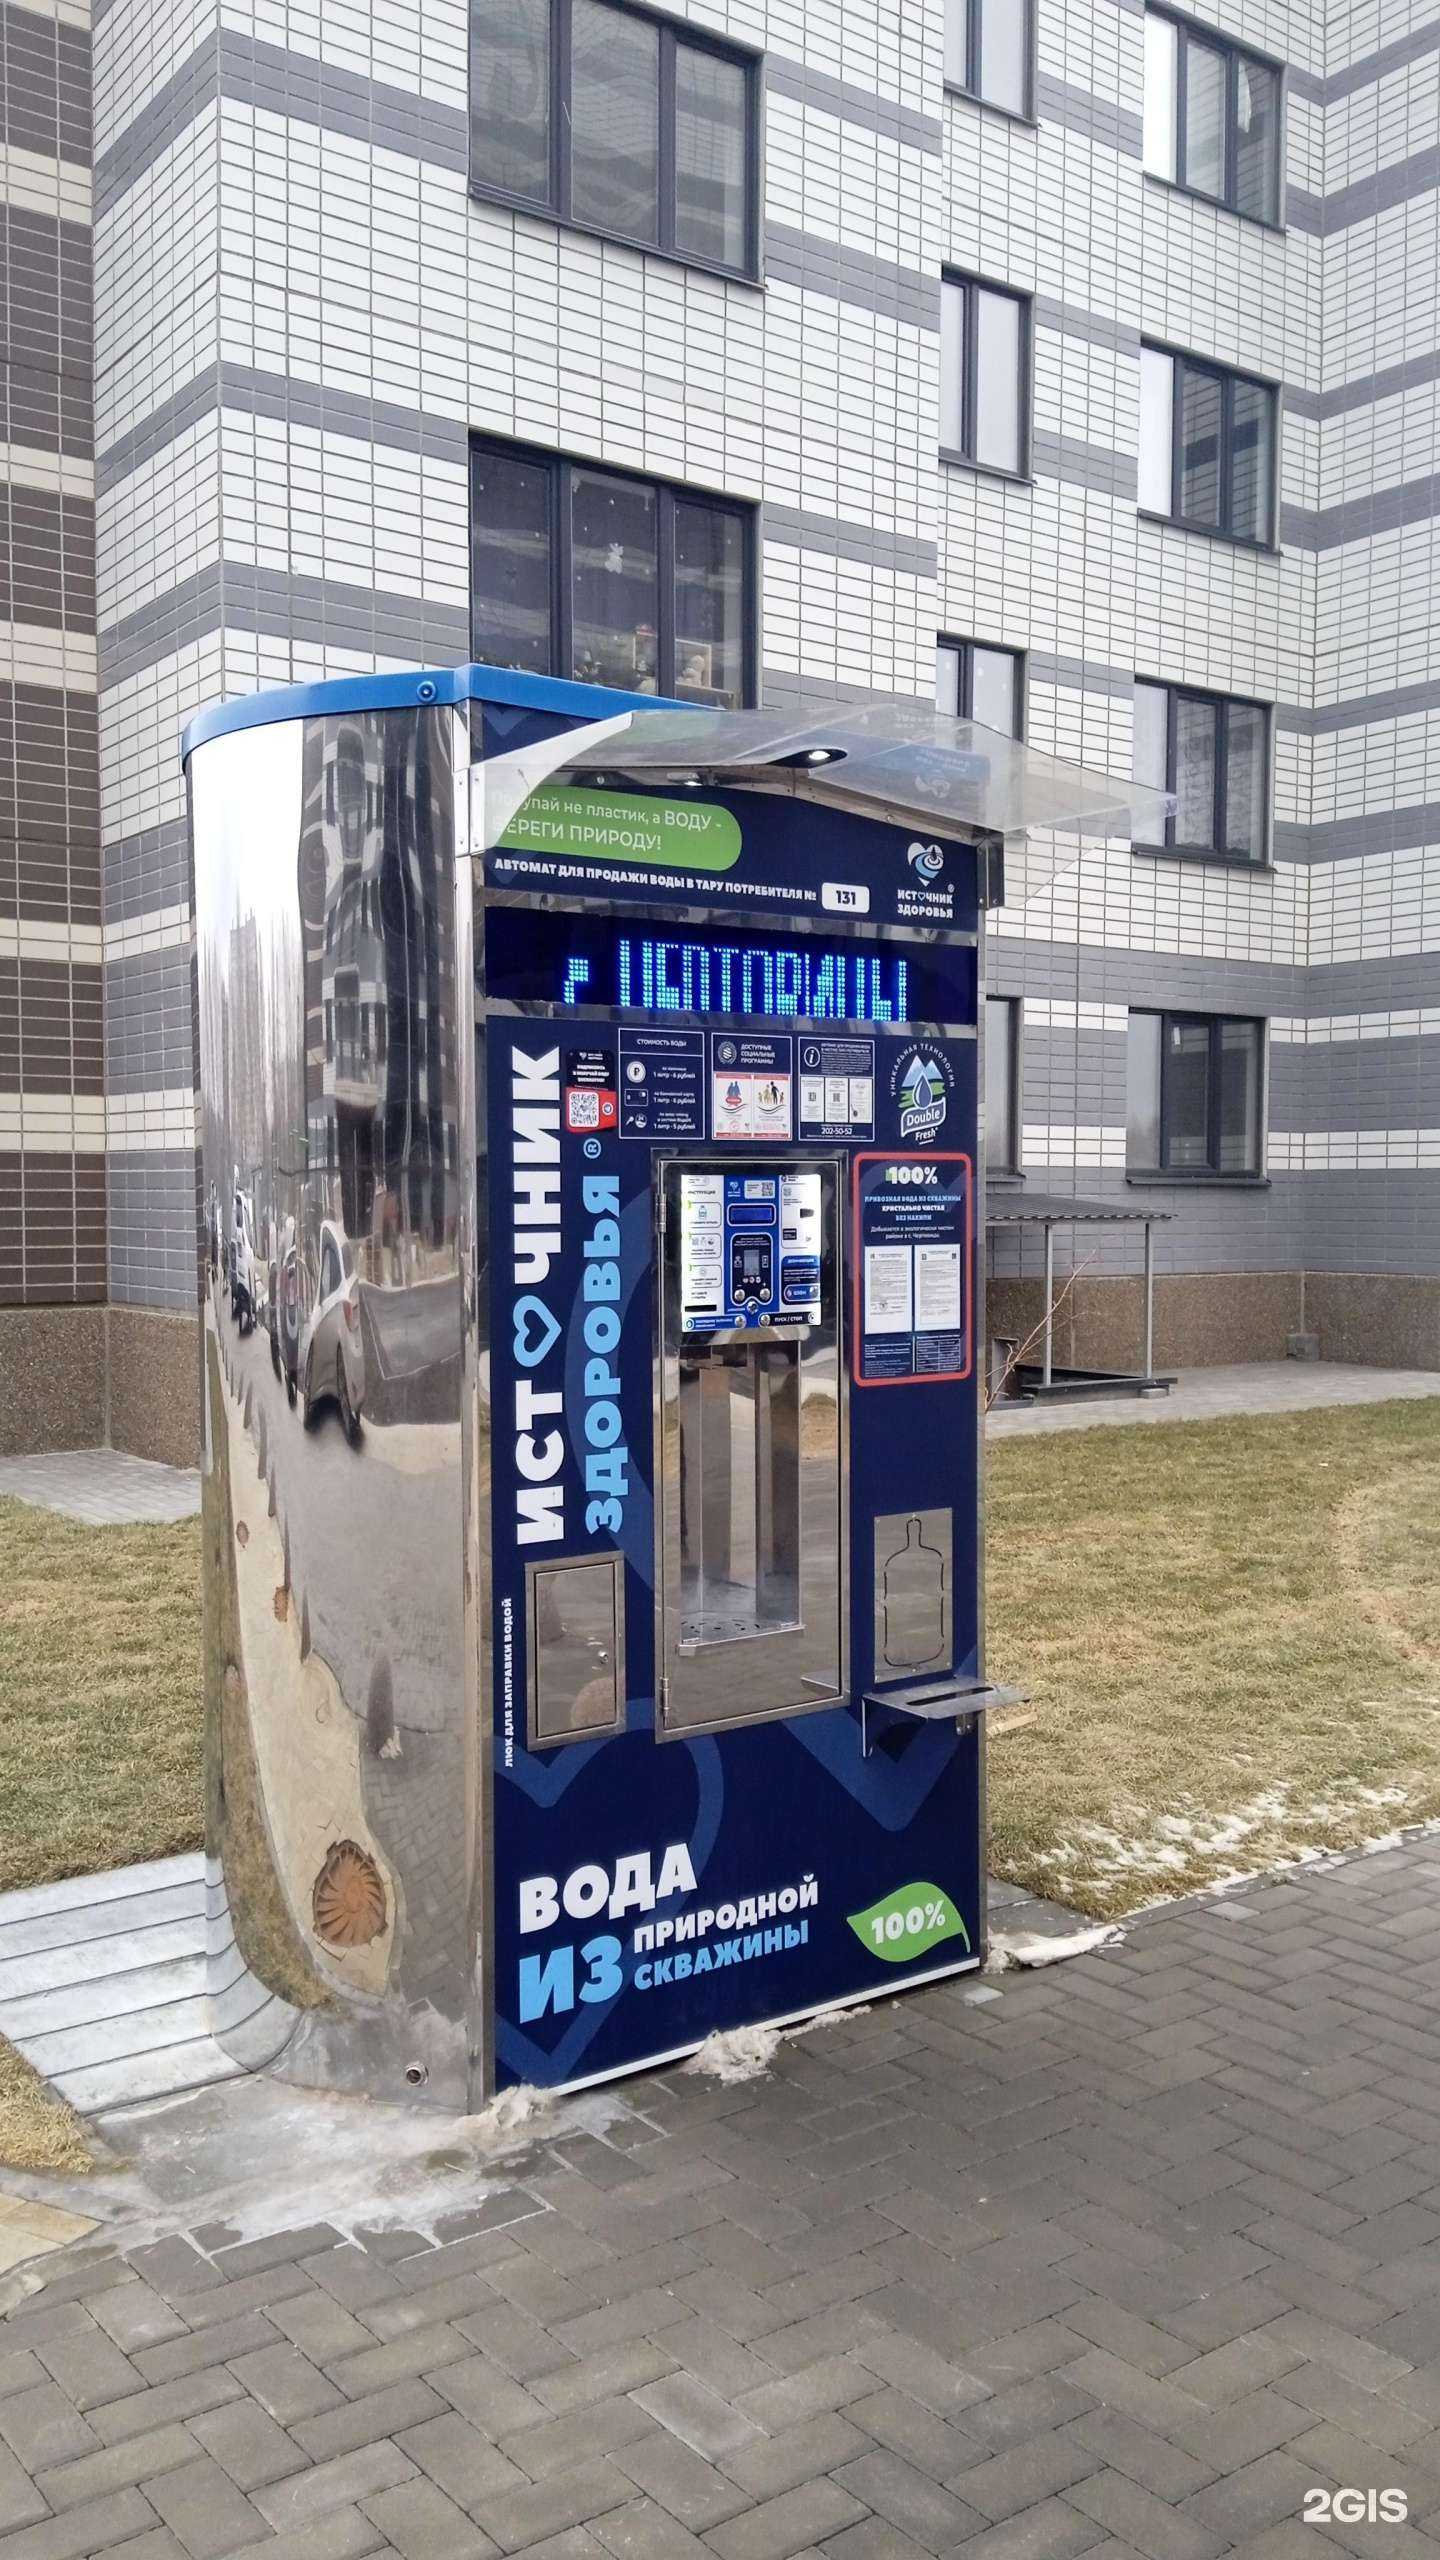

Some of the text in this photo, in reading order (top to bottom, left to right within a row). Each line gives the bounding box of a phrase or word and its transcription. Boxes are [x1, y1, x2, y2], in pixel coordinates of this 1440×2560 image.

[564, 801, 583, 814] не
[586, 803, 650, 824] пластик,
[652, 814, 660, 824] а
[664, 809, 712, 831] ВОДУ
[570, 824, 662, 851] ПРИРОДУ!
[494, 858, 857, 905] АВТОМАТ ДЛЯ ПРОДАЖИ ВОДЫ В ТАРУ ПОТРЕБИТЕЛЯ № 131
[897, 904, 954, 919] ЗДОРОВЬЯ
[890, 1043, 918, 1097] УНИКАЛЬНАЯ
[920, 1043, 955, 1088] ТЕХНОЛОГИЯ
[906, 1107, 941, 1127] Double
[915, 1128, 937, 1141] Fresh
[888, 1166, 938, 1185] 100%
[582, 1175, 629, 1536] ЗДОРОВЬЯ
[501, 1598, 514, 1767] ЛЮК ДЛЯ ЗАПРАВКИ ВОДОЙ
[519, 1842, 697, 1934] ВОДА
[634, 1873, 819, 1954] ПРИРОДНОЙ
[871, 1899, 946, 1944] 100%
[519, 1919, 809, 2024] ИЗ СКВАЖИНЫ
